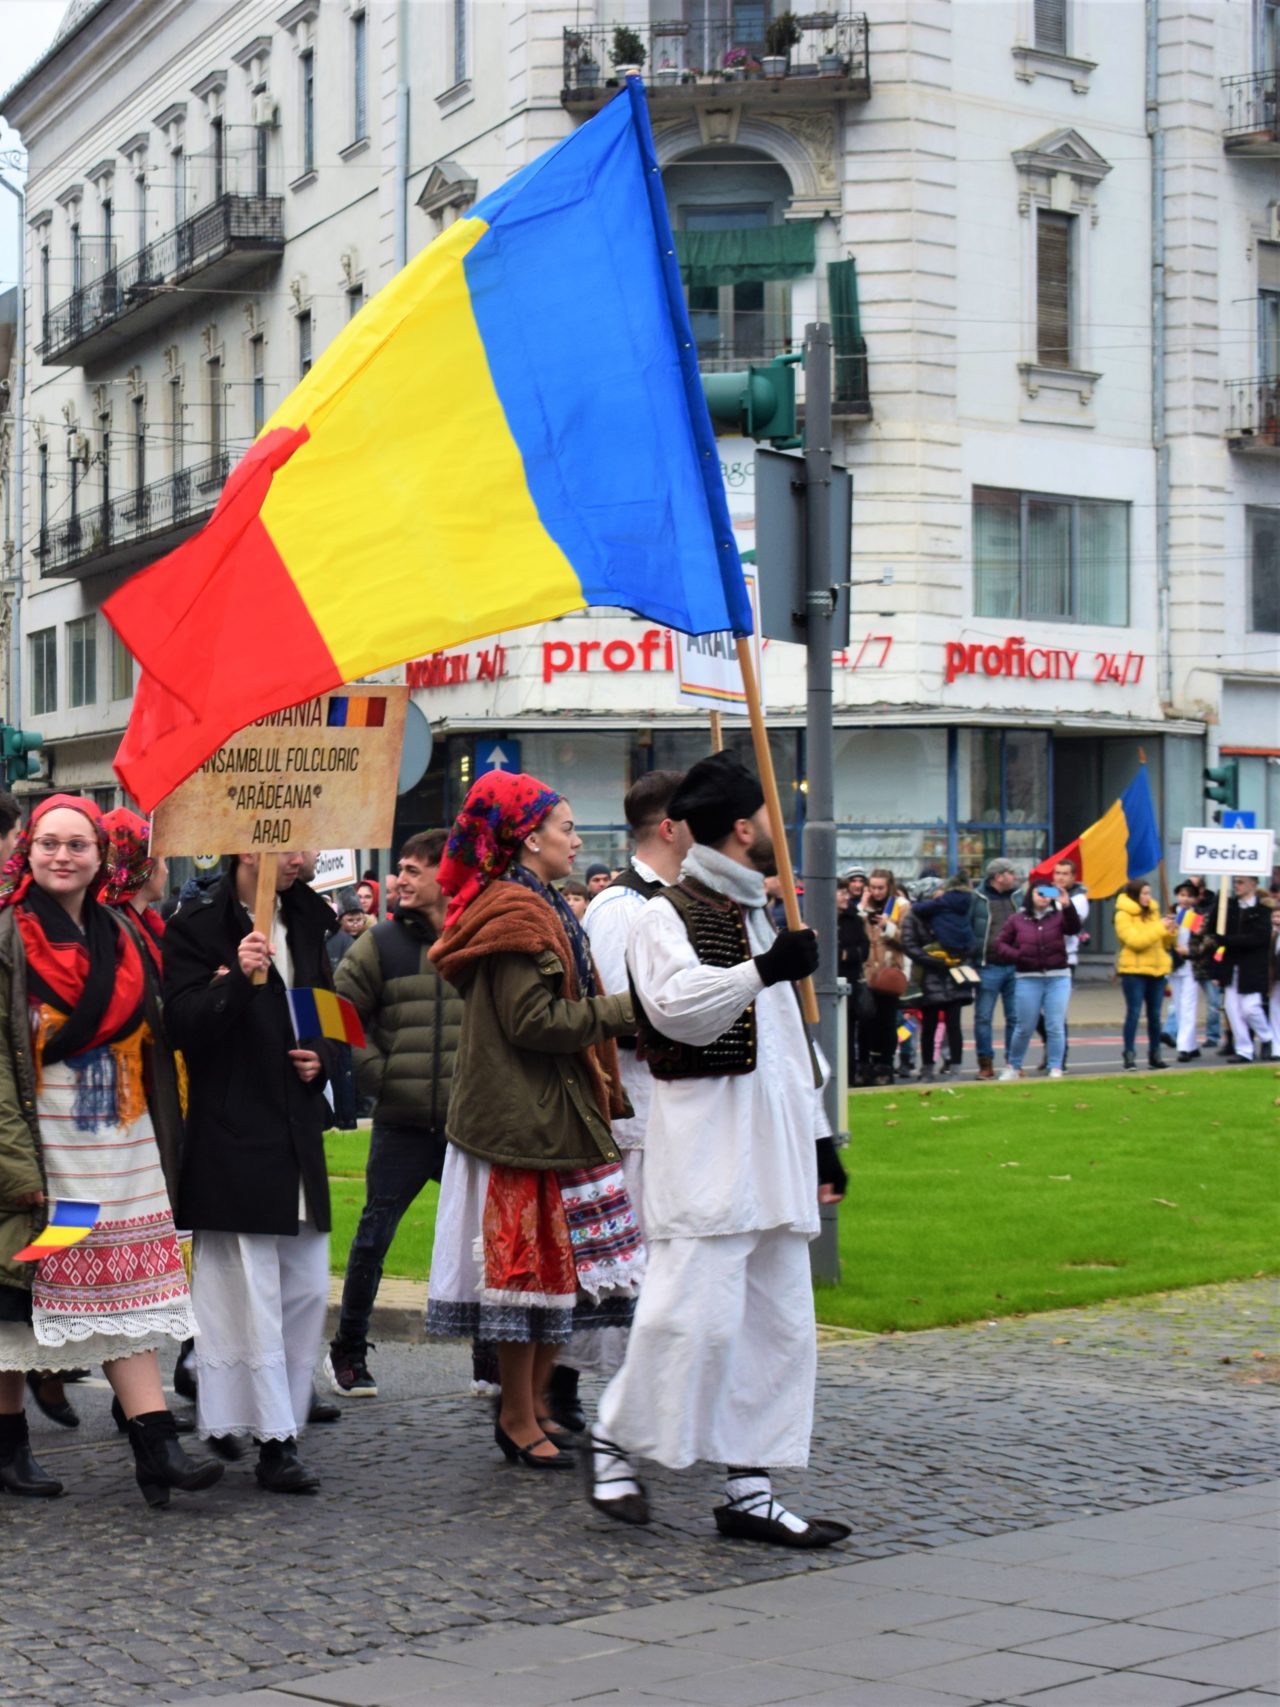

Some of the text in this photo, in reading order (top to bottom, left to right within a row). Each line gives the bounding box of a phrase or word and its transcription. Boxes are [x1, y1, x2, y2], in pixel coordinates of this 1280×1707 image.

[945, 637, 1144, 686] profiCITY 24/7
[285, 747, 359, 772] FOLCLORIC
[251, 819, 291, 844] ARAD
[1195, 844, 1259, 861] Pecica
